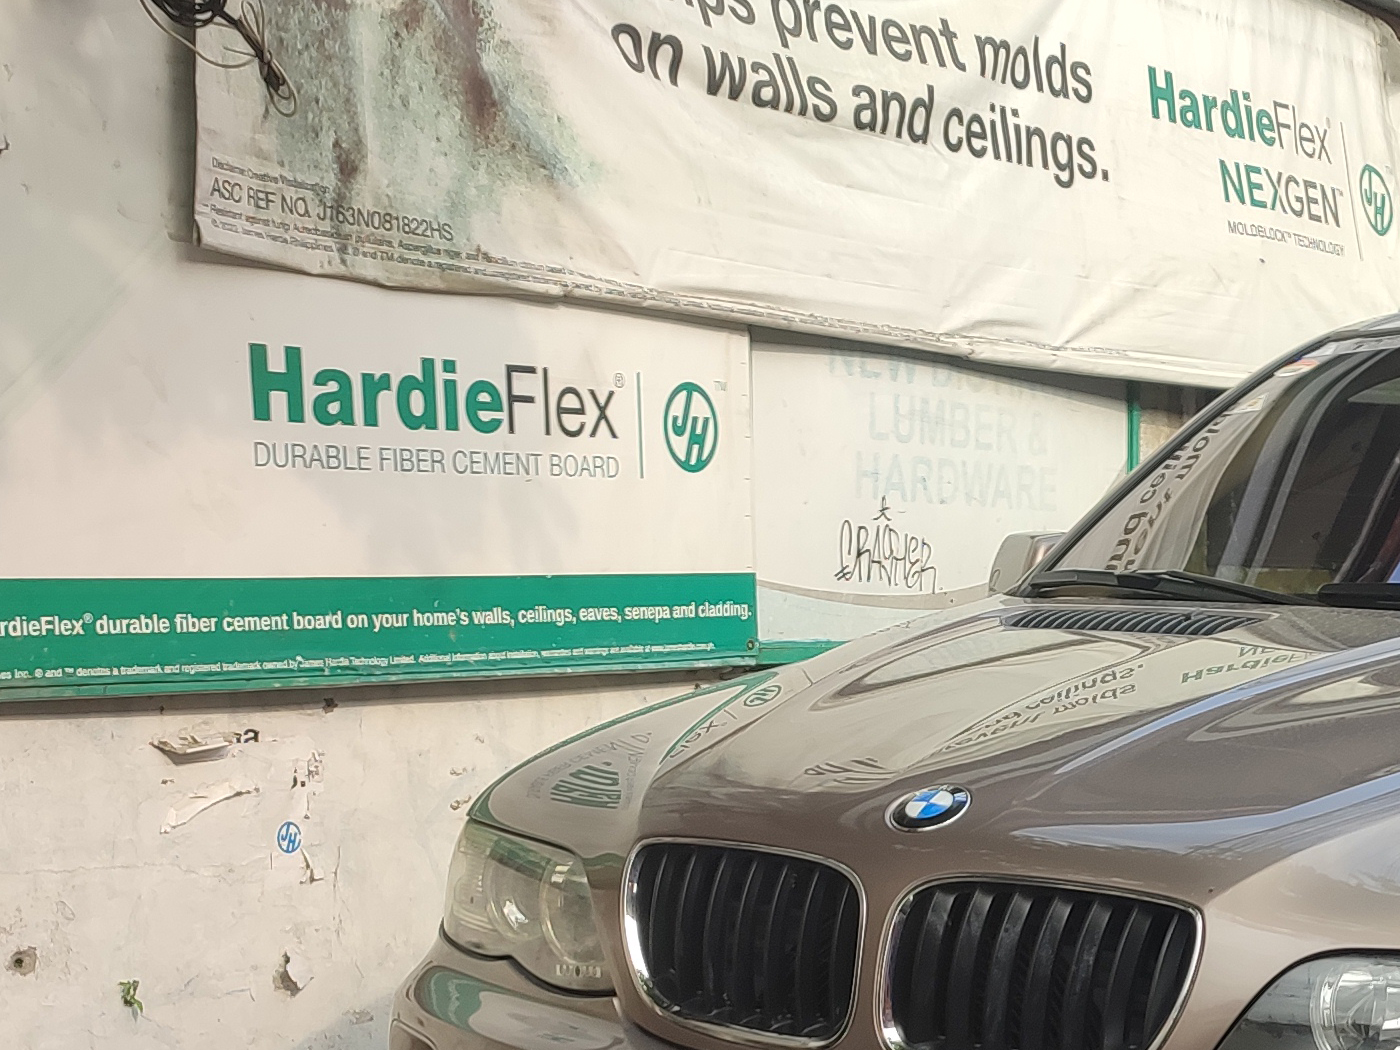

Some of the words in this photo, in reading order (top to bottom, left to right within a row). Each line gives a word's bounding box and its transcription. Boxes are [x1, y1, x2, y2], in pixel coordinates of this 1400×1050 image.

[772, 0, 966, 73] prevent
[974, 32, 1093, 104] molds
[611, 23, 683, 87] on
[702, 44, 838, 123] walls
[852, 84, 934, 145] and
[943, 102, 1110, 189] ceilings.
[210, 177, 242, 203] ASC
[247, 185, 276, 210] REF
[281, 193, 311, 218] NO.
[254, 442, 371, 471] DURABLE
[379, 448, 444, 474] FIBER
[453, 450, 543, 477] CEMENT
[550, 454, 619, 479] BOARD
[856, 450, 1057, 511] HARDWARE
[96, 614, 170, 635] durable
[175, 613, 217, 634] fiber
[222, 612, 288, 632] cement
[292, 611, 342, 630] board
[347, 615, 368, 629] on
[373, 612, 409, 632] your
[413, 609, 469, 626] home's
[472, 607, 515, 628] walls,
[518, 605, 577, 627] ceilings,
[579, 606, 622, 623] eaves,
[624, 605, 671, 623] senepa
[673, 602, 695, 619] and
[698, 600, 752, 620] cladding.
[45, 668, 62, 677] and
